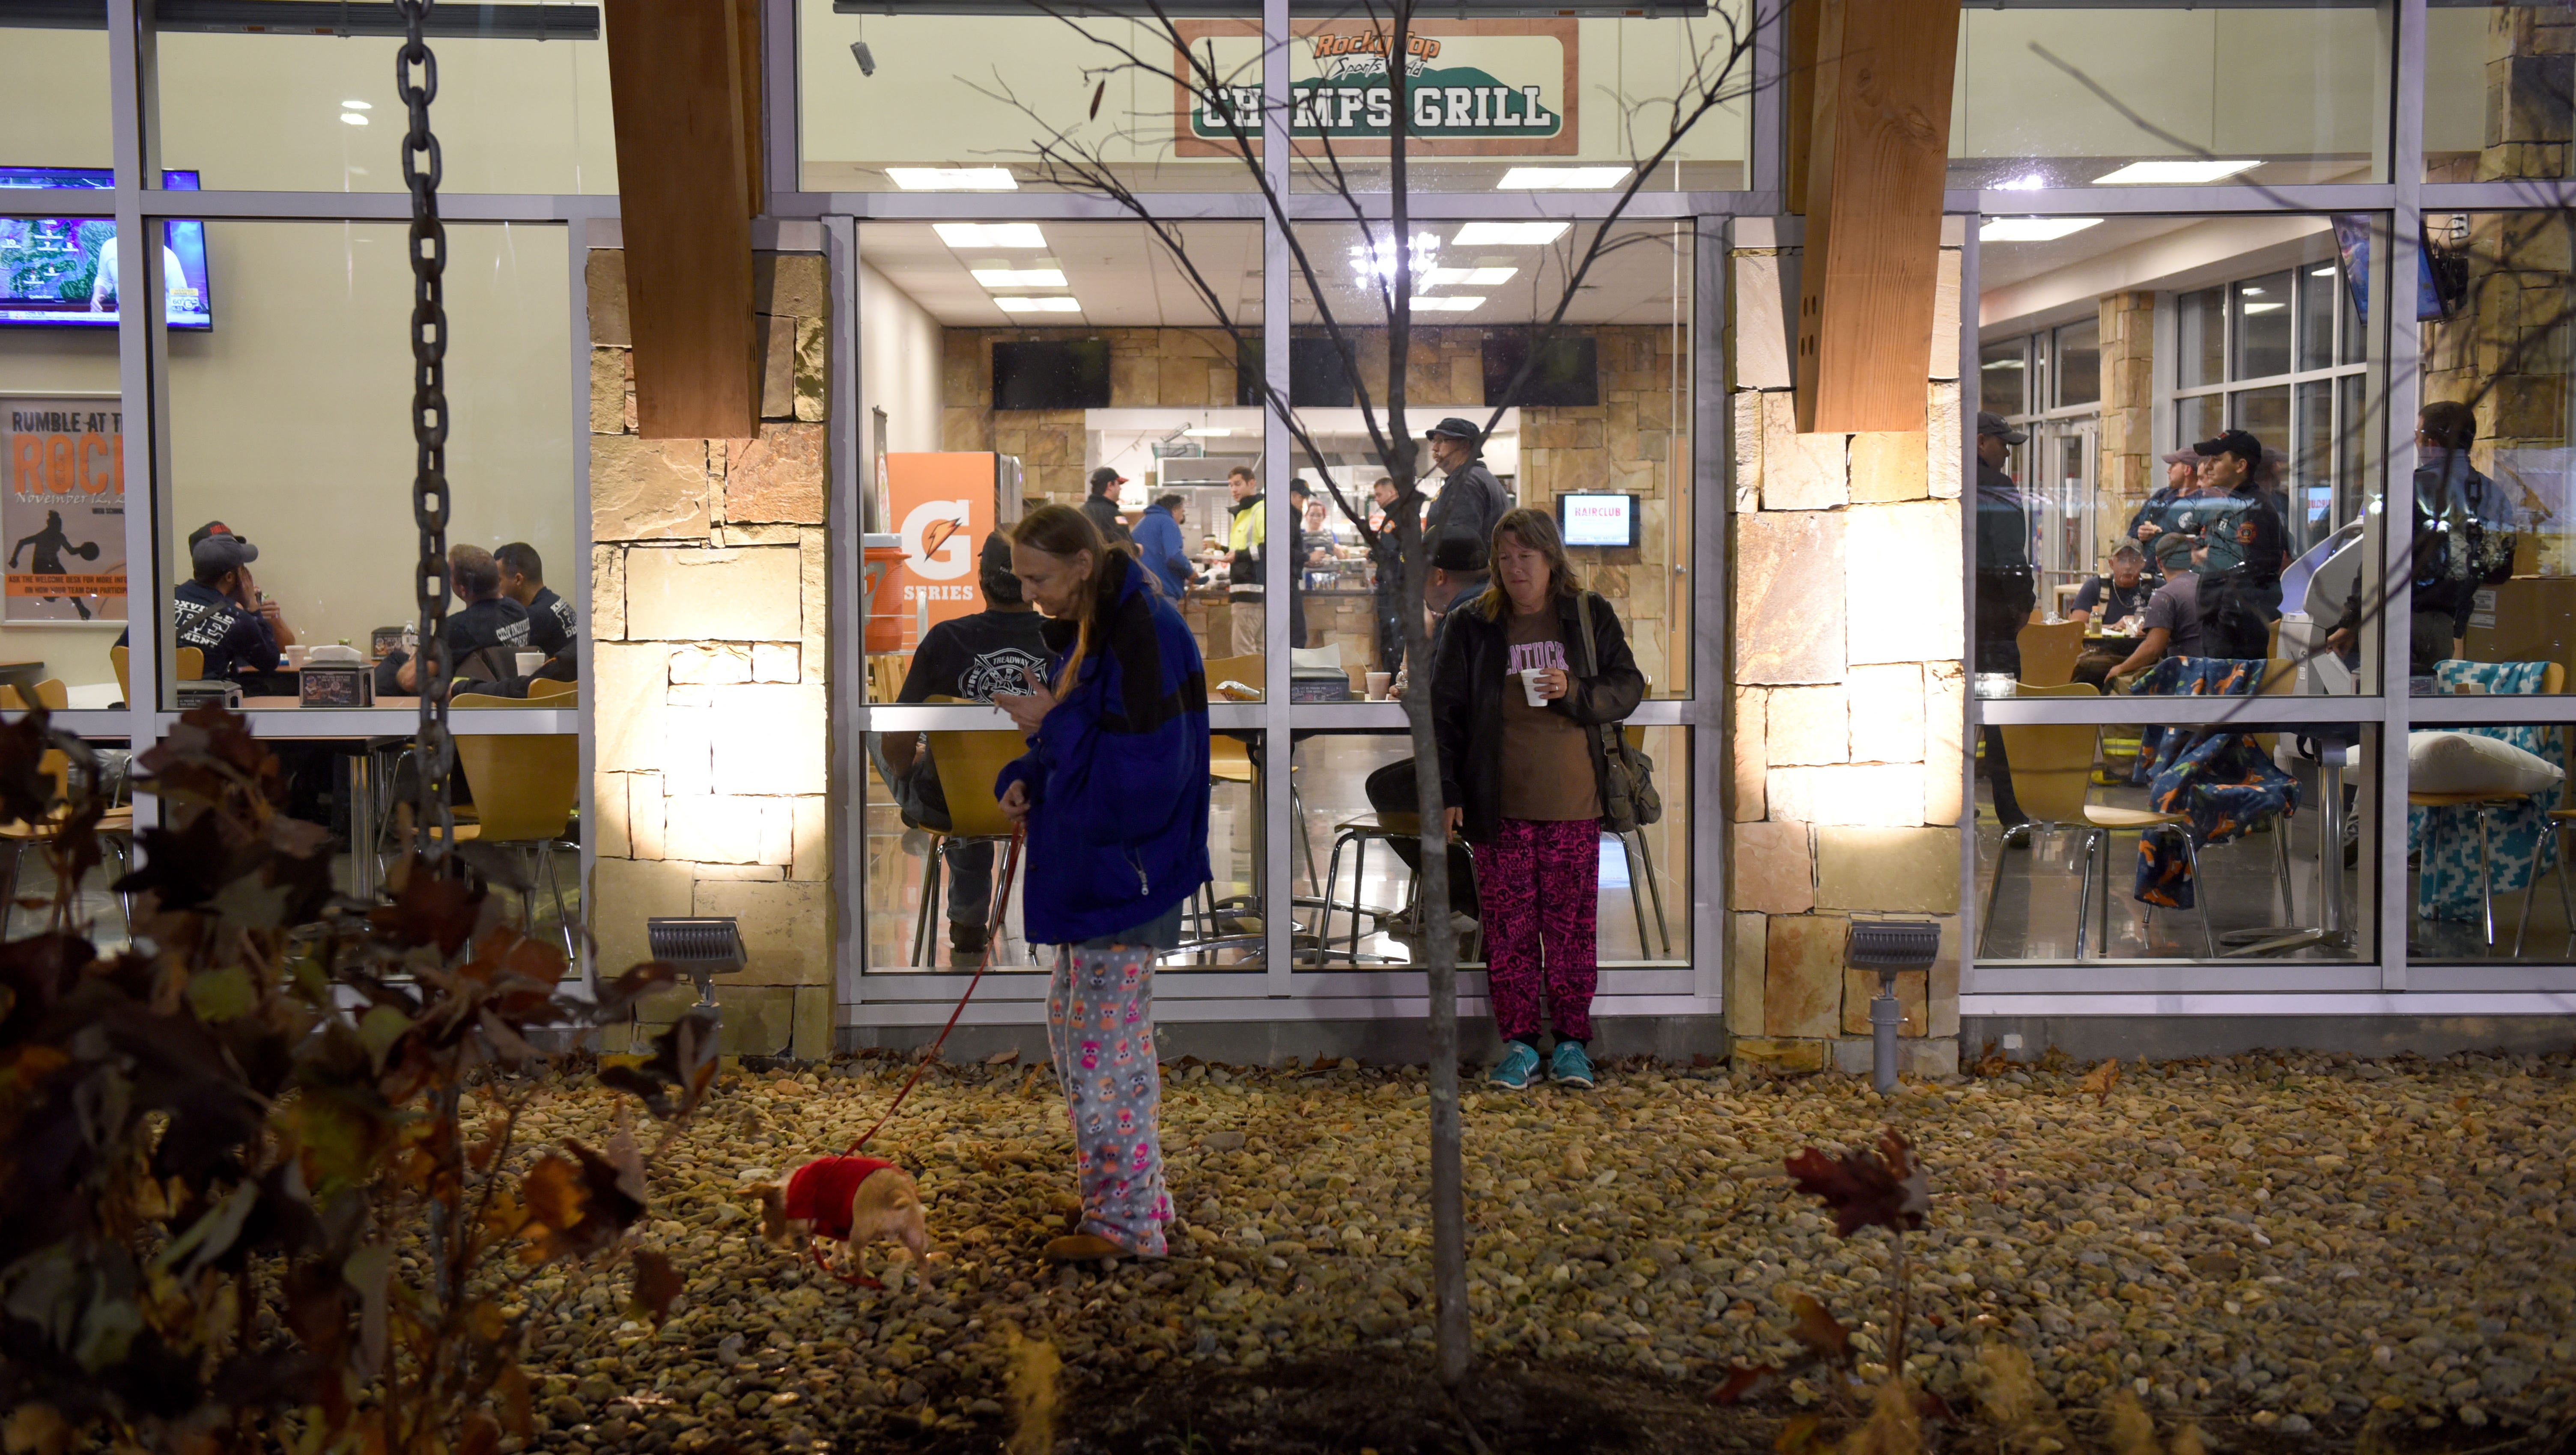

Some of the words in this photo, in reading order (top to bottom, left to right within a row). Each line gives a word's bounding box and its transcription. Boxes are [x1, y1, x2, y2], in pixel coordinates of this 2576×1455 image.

[1313, 30, 1394, 59] Rocky
[1406, 31, 1441, 62] op
[1386, 57, 1425, 76] rld
[1202, 87, 1392, 128] CHMPS
[1413, 86, 1551, 127] GRILL
[12, 412, 81, 432] RUMBLE
[87, 413, 107, 433] AT
[15, 489, 88, 505] November
[900, 499, 971, 580] G
[903, 585, 973, 601] SERIES
[993, 656, 1029, 667] TREADWAY
[1506, 641, 1569, 675] NTUCK
[967, 666, 984, 696] FIRE
